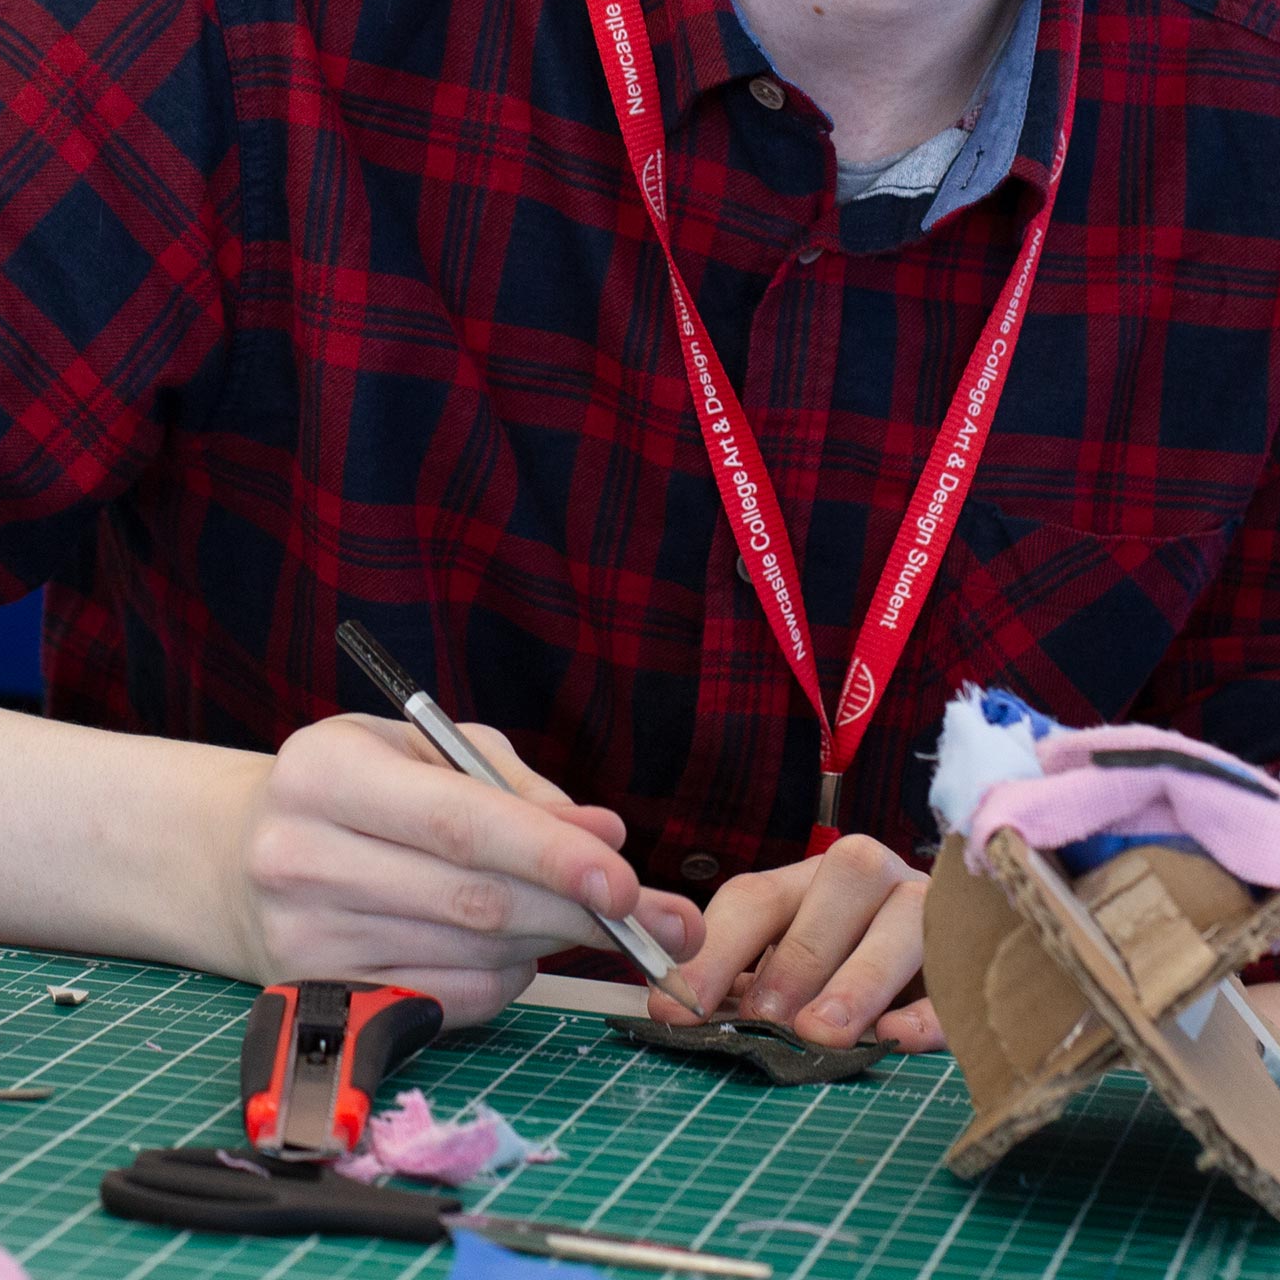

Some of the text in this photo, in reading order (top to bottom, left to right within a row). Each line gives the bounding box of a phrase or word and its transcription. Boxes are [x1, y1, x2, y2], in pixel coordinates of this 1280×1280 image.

[605, 3, 645, 115] Newcastle
[690, 342, 723, 415] Design
[712, 417, 728, 433] &
[719, 436, 744, 467] Art
[880, 229, 1042, 629] Newcastle College Art & Design Student
[733, 471, 771, 551] College
[763, 553, 806, 660] Newcastle
